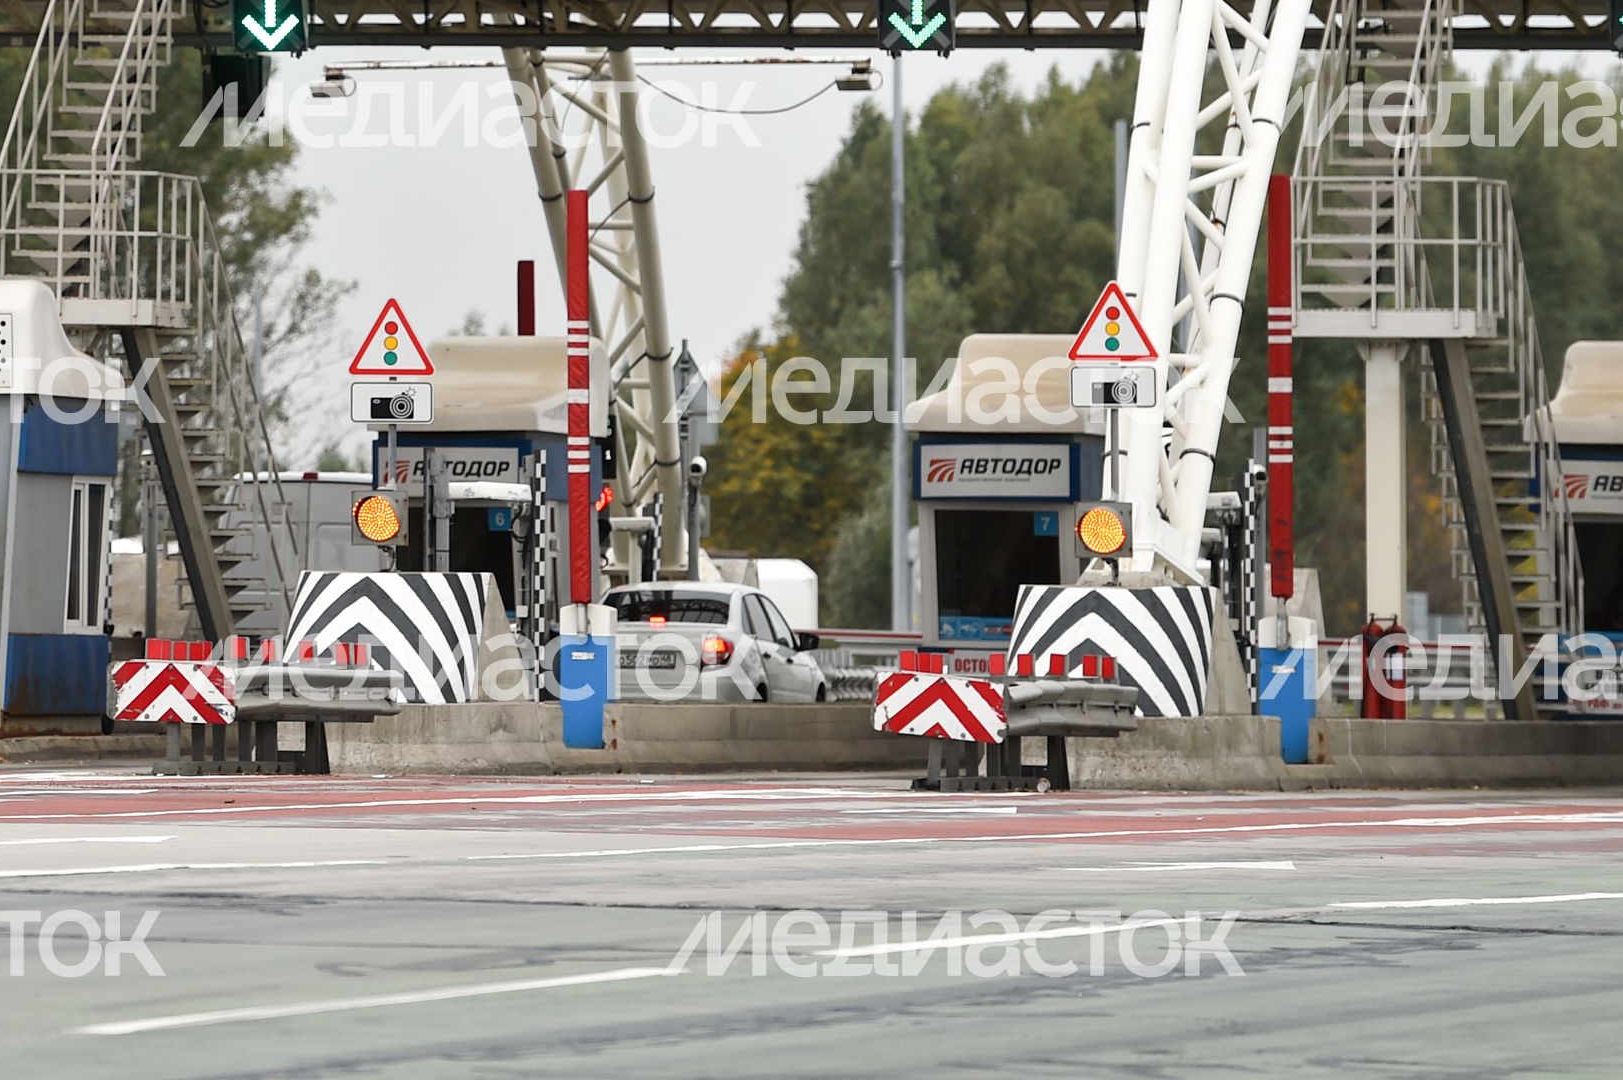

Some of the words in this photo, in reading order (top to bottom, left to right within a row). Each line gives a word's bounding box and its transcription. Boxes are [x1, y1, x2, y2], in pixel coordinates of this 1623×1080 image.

[413, 461, 509, 477] АТОДОР
[960, 458, 1061, 476] АВТОДОР
[495, 512, 505, 527] 6
[1040, 516, 1050, 531] 7
[955, 658, 990, 673] ОСТО
